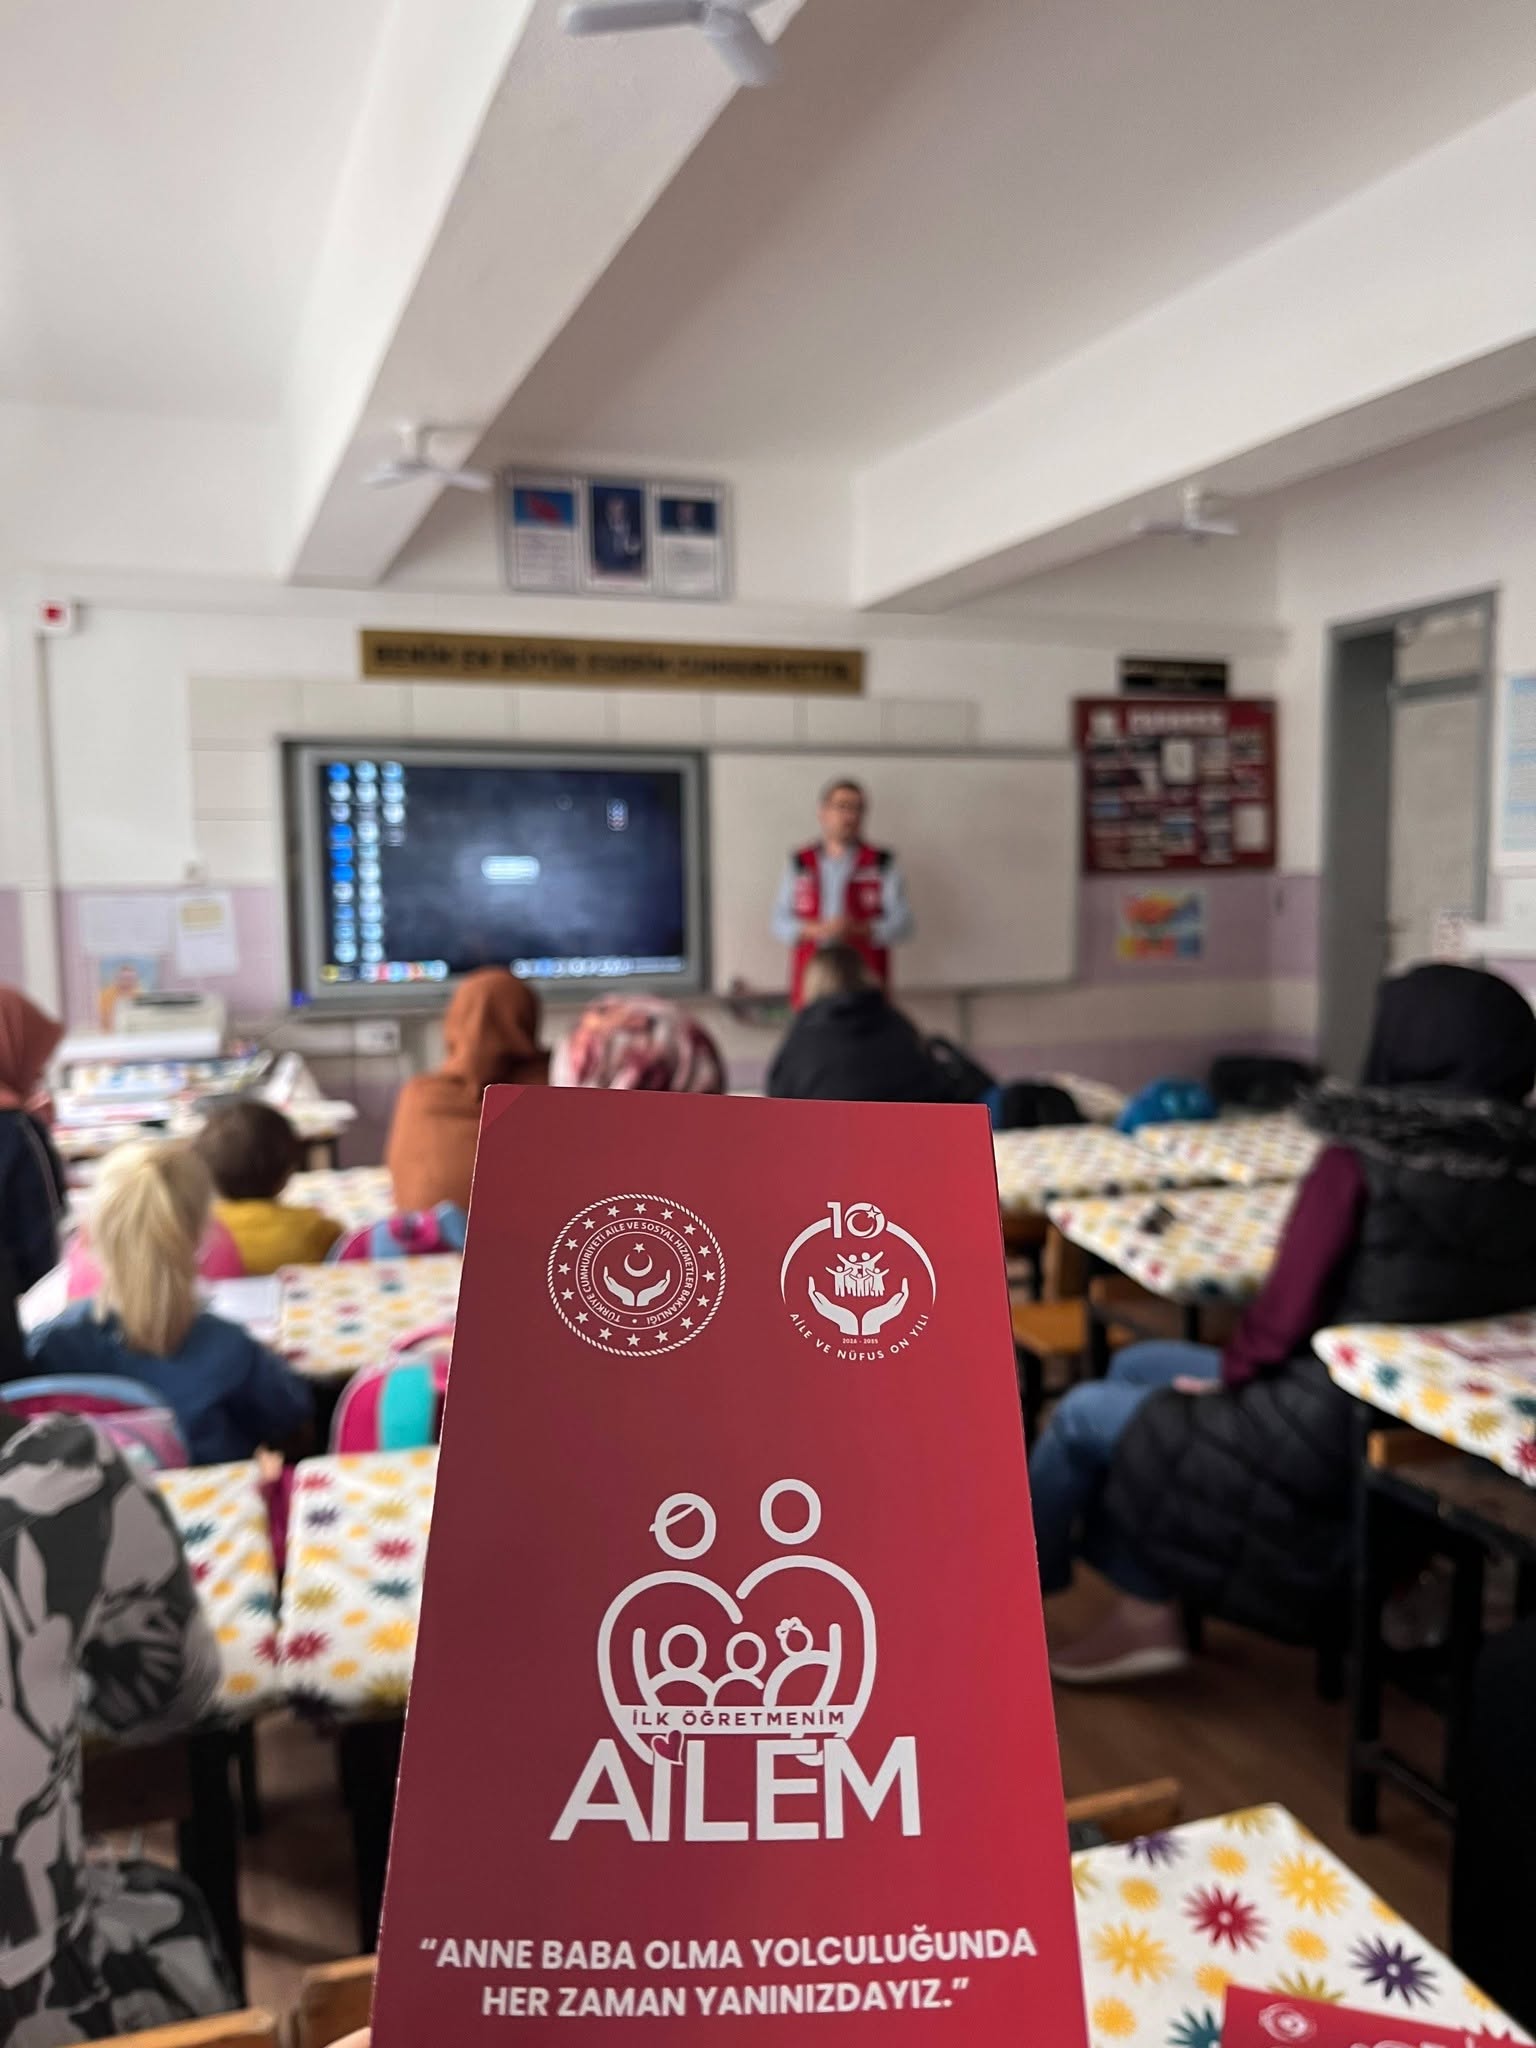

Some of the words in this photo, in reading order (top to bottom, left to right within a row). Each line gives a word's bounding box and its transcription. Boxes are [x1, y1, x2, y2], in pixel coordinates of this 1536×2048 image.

[605, 1223, 626, 1237] AİLE
[626, 1221, 639, 1230] VE
[641, 1222, 675, 1242] SOSYAL
[580, 1232, 607, 1293] CUMHURİYETİ
[673, 1239, 695, 1289] HİZMETLER
[586, 1292, 621, 1323] TÜRKİYE
[646, 1289, 691, 1325] BAKANLIĞI
[789, 1313, 813, 1339] AİLE
[815, 1338, 832, 1354] VE
[837, 1349, 885, 1362] NÜFUS
[889, 1338, 910, 1354] ON
[909, 1313, 929, 1338] YILI
[632, 1709, 670, 1727] İLK
[682, 1709, 845, 1727] ÖĞRETMENİM
[542, 1939, 637, 1970] BABA
[644, 1939, 744, 1970] OLMA
[751, 1923, 1038, 1968] YOLCULUĞUNDA
[481, 1986, 550, 2017] HER
[557, 1986, 687, 2017] ZAMAN
